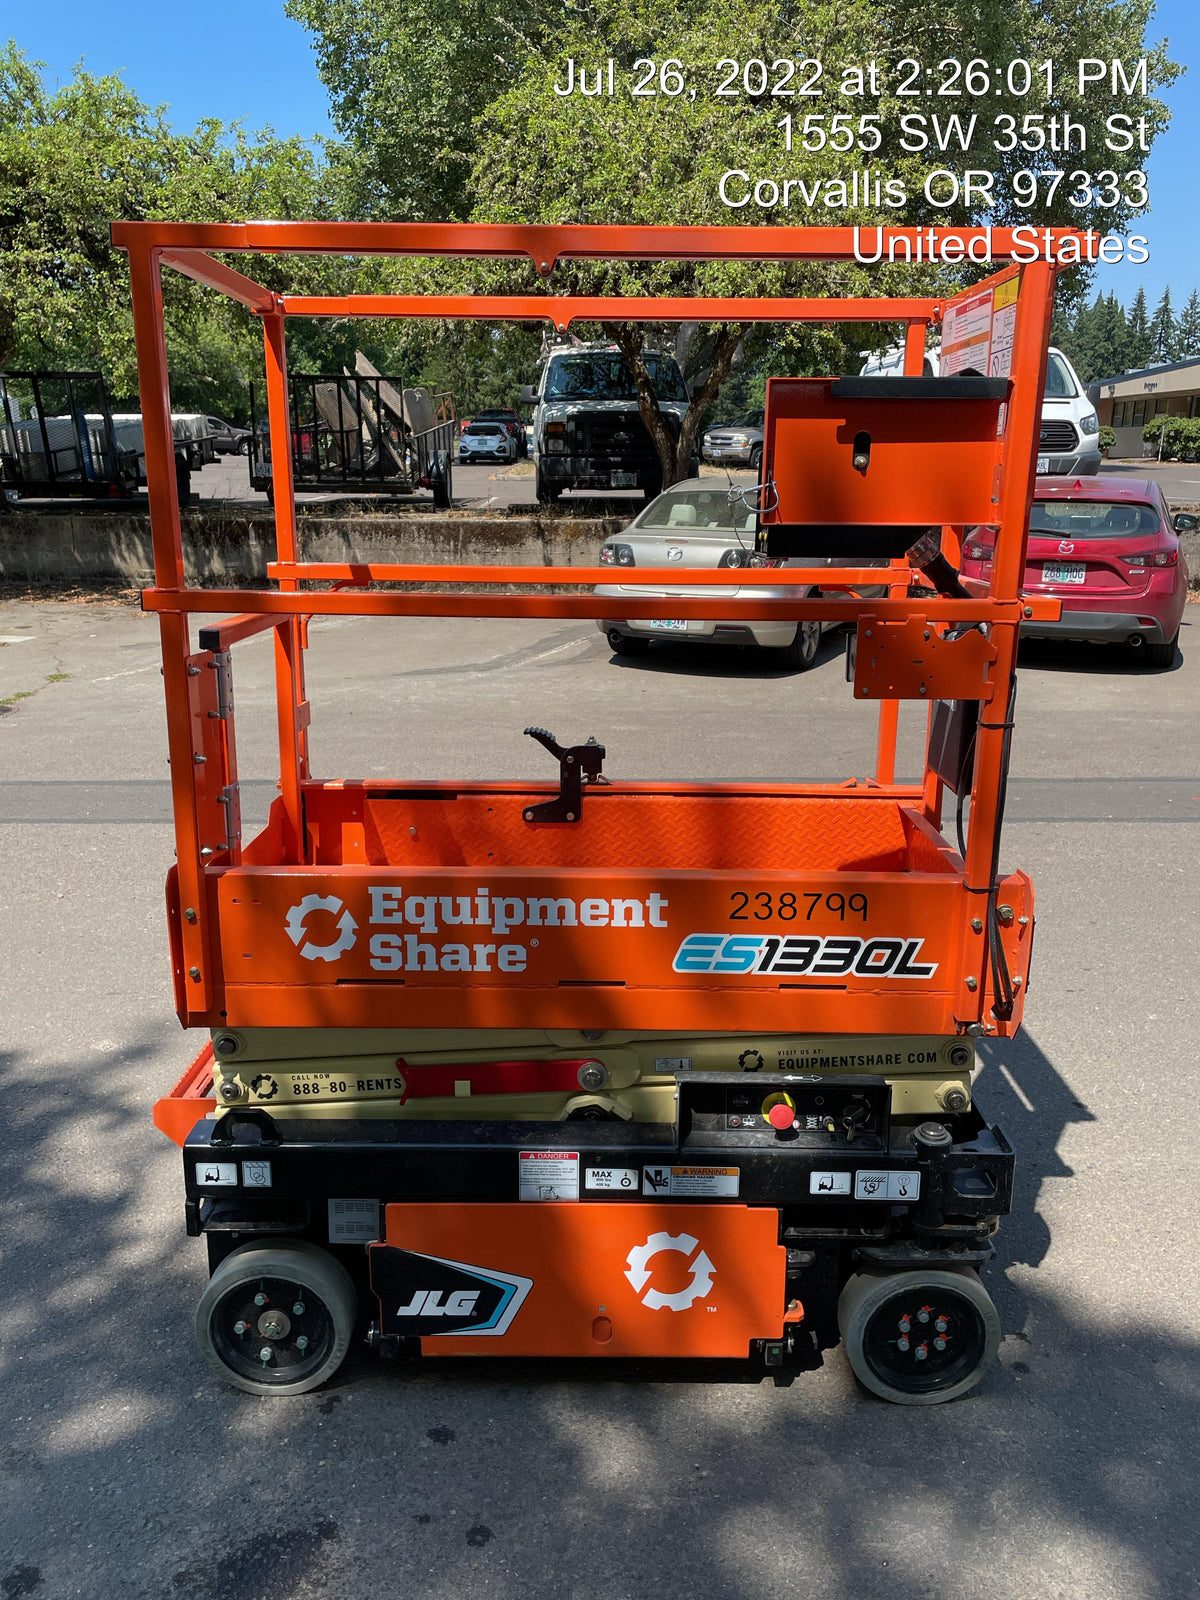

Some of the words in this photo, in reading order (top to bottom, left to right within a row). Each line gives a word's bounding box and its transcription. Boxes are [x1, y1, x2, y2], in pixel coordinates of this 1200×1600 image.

[368, 886, 669, 935] Equipment
[728, 891, 869, 921] 238799
[369, 933, 527, 972] Share
[673, 933, 939, 979] ES1330L
[293, 1078, 402, 1095] 888-80-RENTS
[591, 1170, 613, 1178] MAX
[690, 1168, 728, 1176] WARNING
[396, 1290, 481, 1316] JLG
